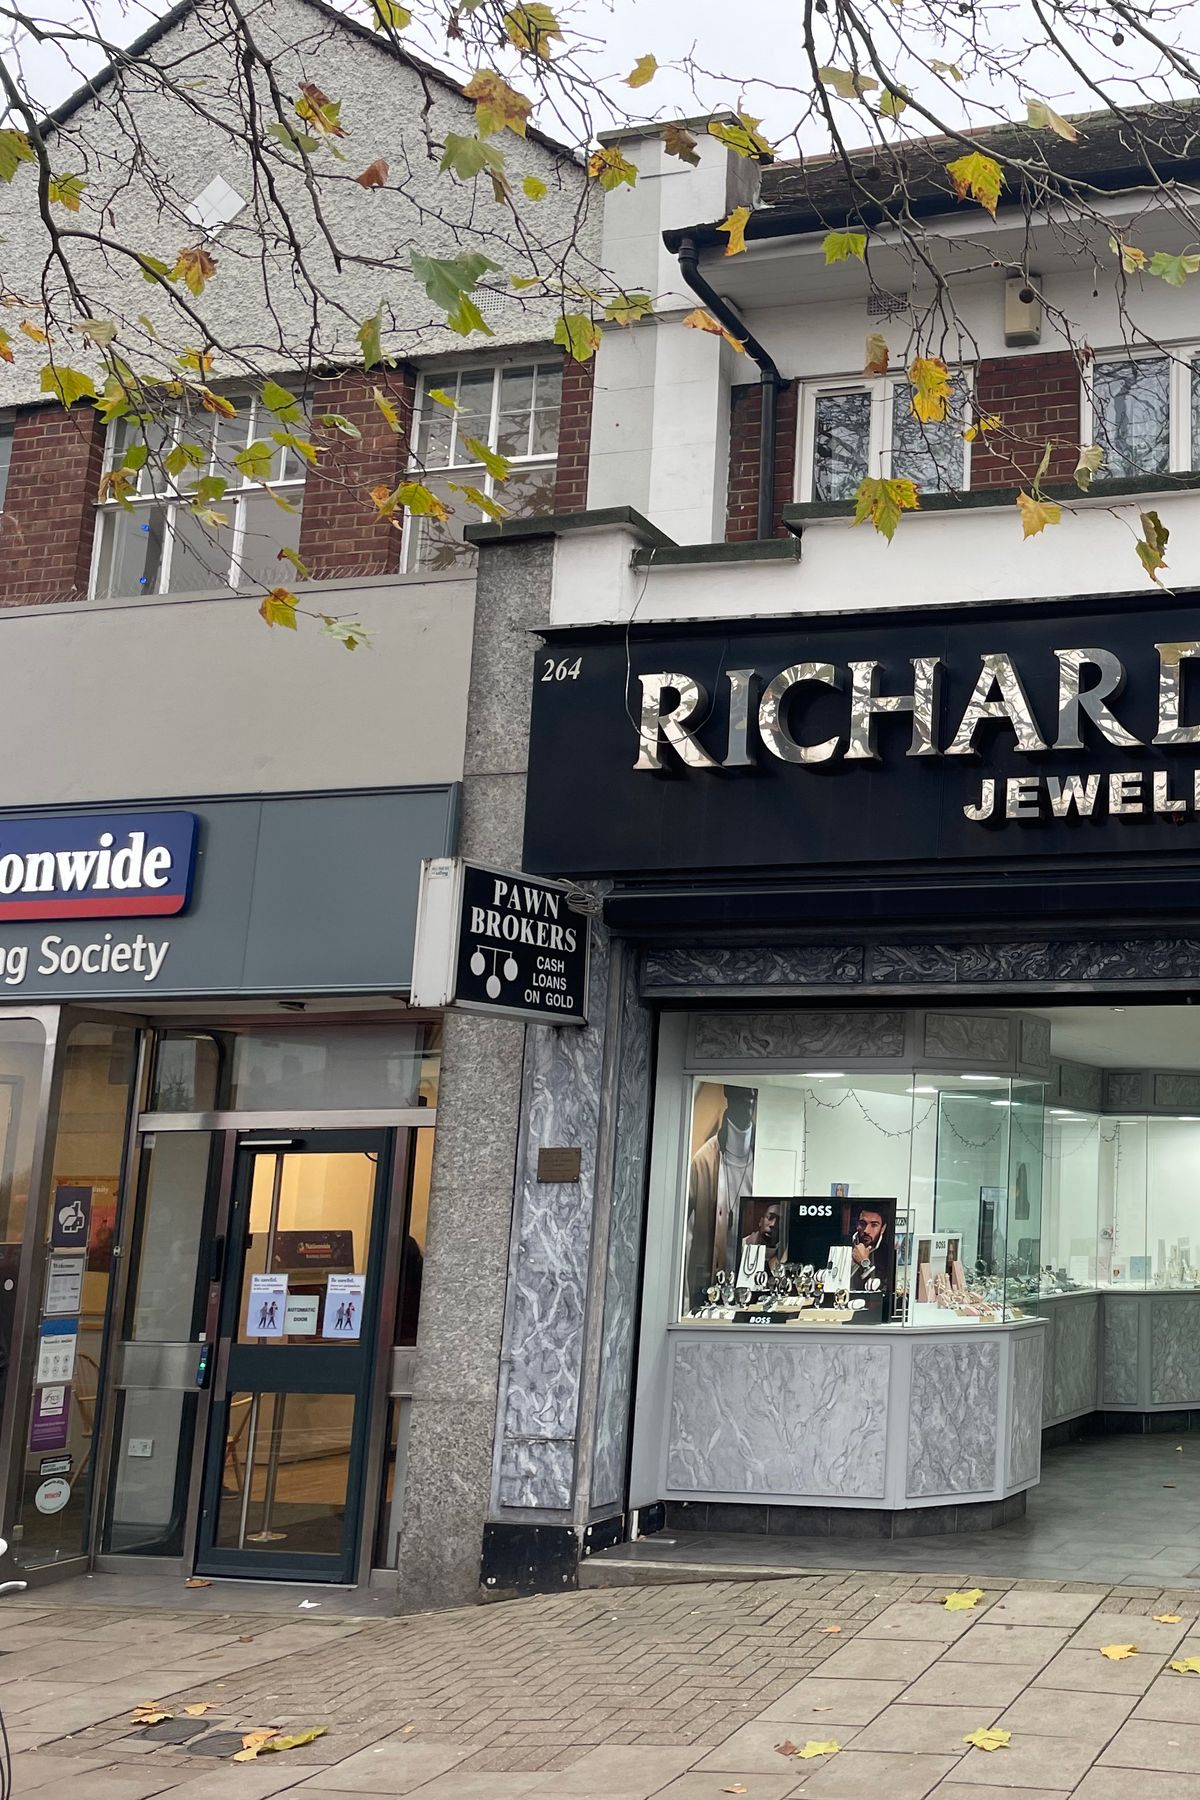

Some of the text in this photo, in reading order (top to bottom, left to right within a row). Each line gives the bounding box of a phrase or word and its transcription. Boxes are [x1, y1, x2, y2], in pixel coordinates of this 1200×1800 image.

[540, 656, 582, 682] 264
[0, 831, 172, 894] onwide
[492, 879, 560, 920] PAWN
[470, 906, 577, 952] BROKERS
[38, 933, 170, 981] Society
[536, 956, 565, 973] CASH
[532, 973, 567, 990] LOANS
[524, 989, 574, 1009] ON GOLD
[799, 1204, 833, 1217] BOSS
[749, 1316, 771, 1324] BOSS
